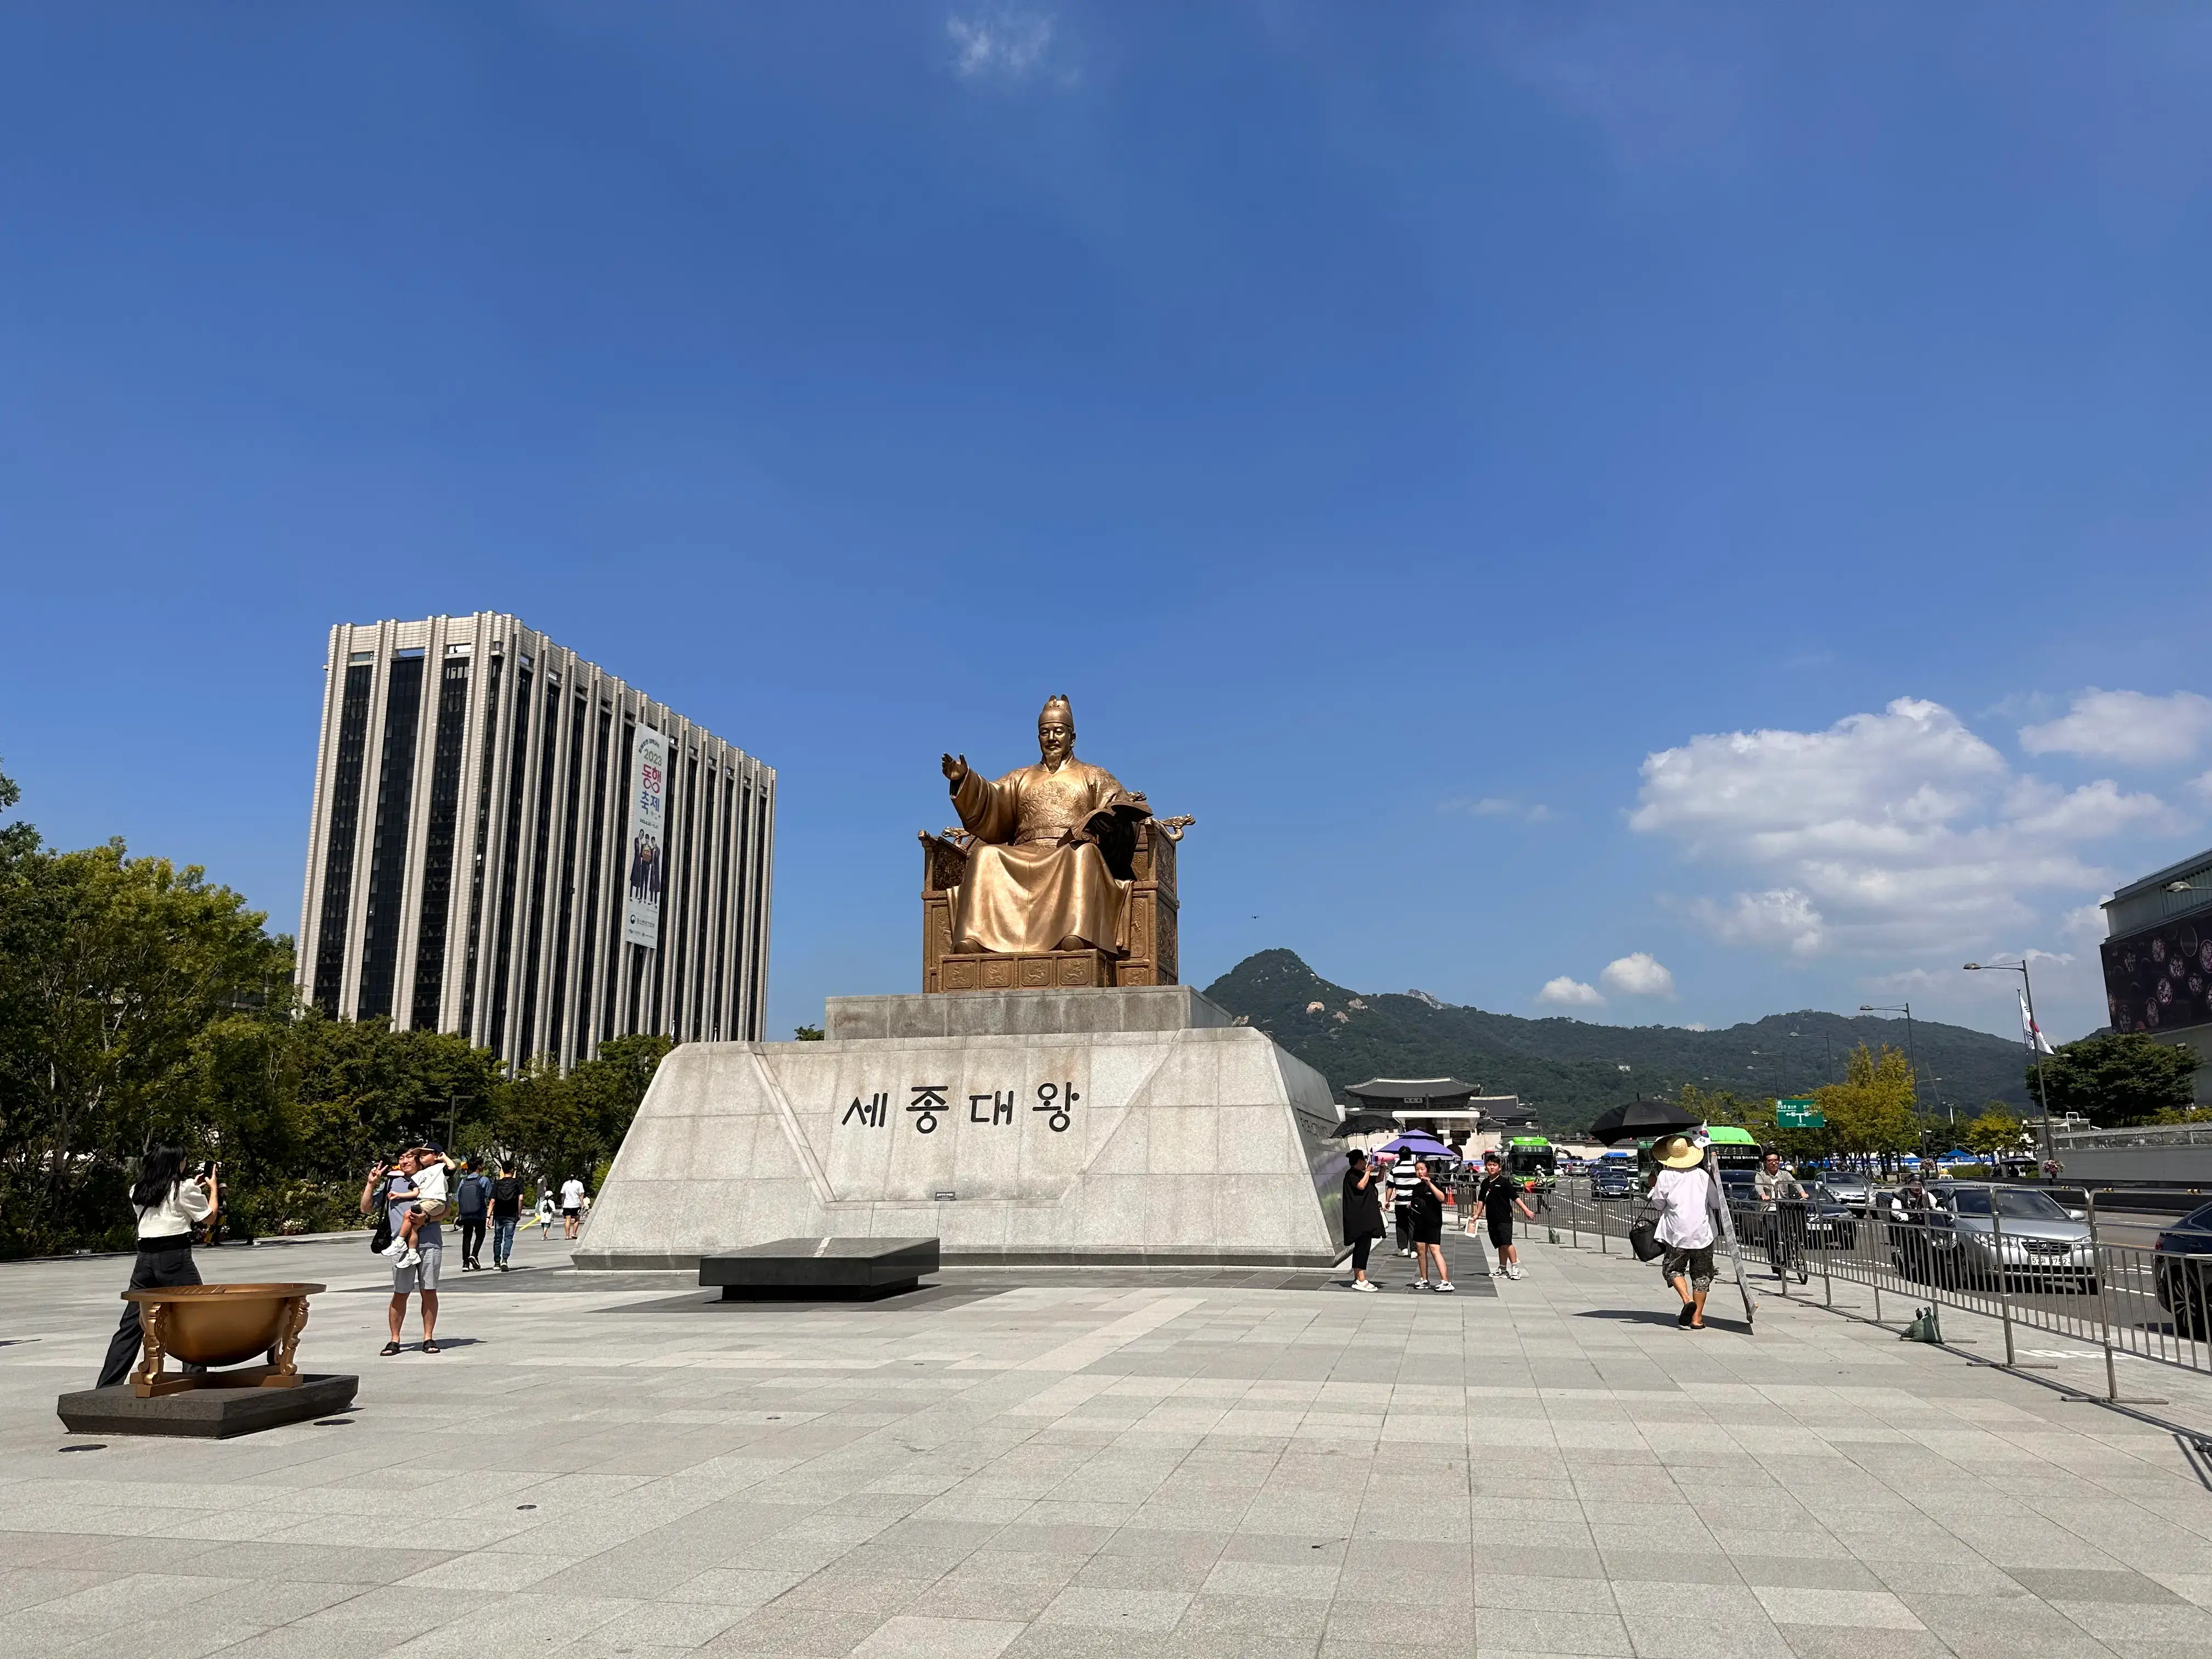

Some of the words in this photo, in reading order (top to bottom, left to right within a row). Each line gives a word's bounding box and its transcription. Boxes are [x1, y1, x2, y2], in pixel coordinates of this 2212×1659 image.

[644, 748, 662, 766] 2023
[642, 764, 662, 794] 동행
[640, 790, 660, 815] 축제
[842, 1082, 1080, 1134] 세종대왕
